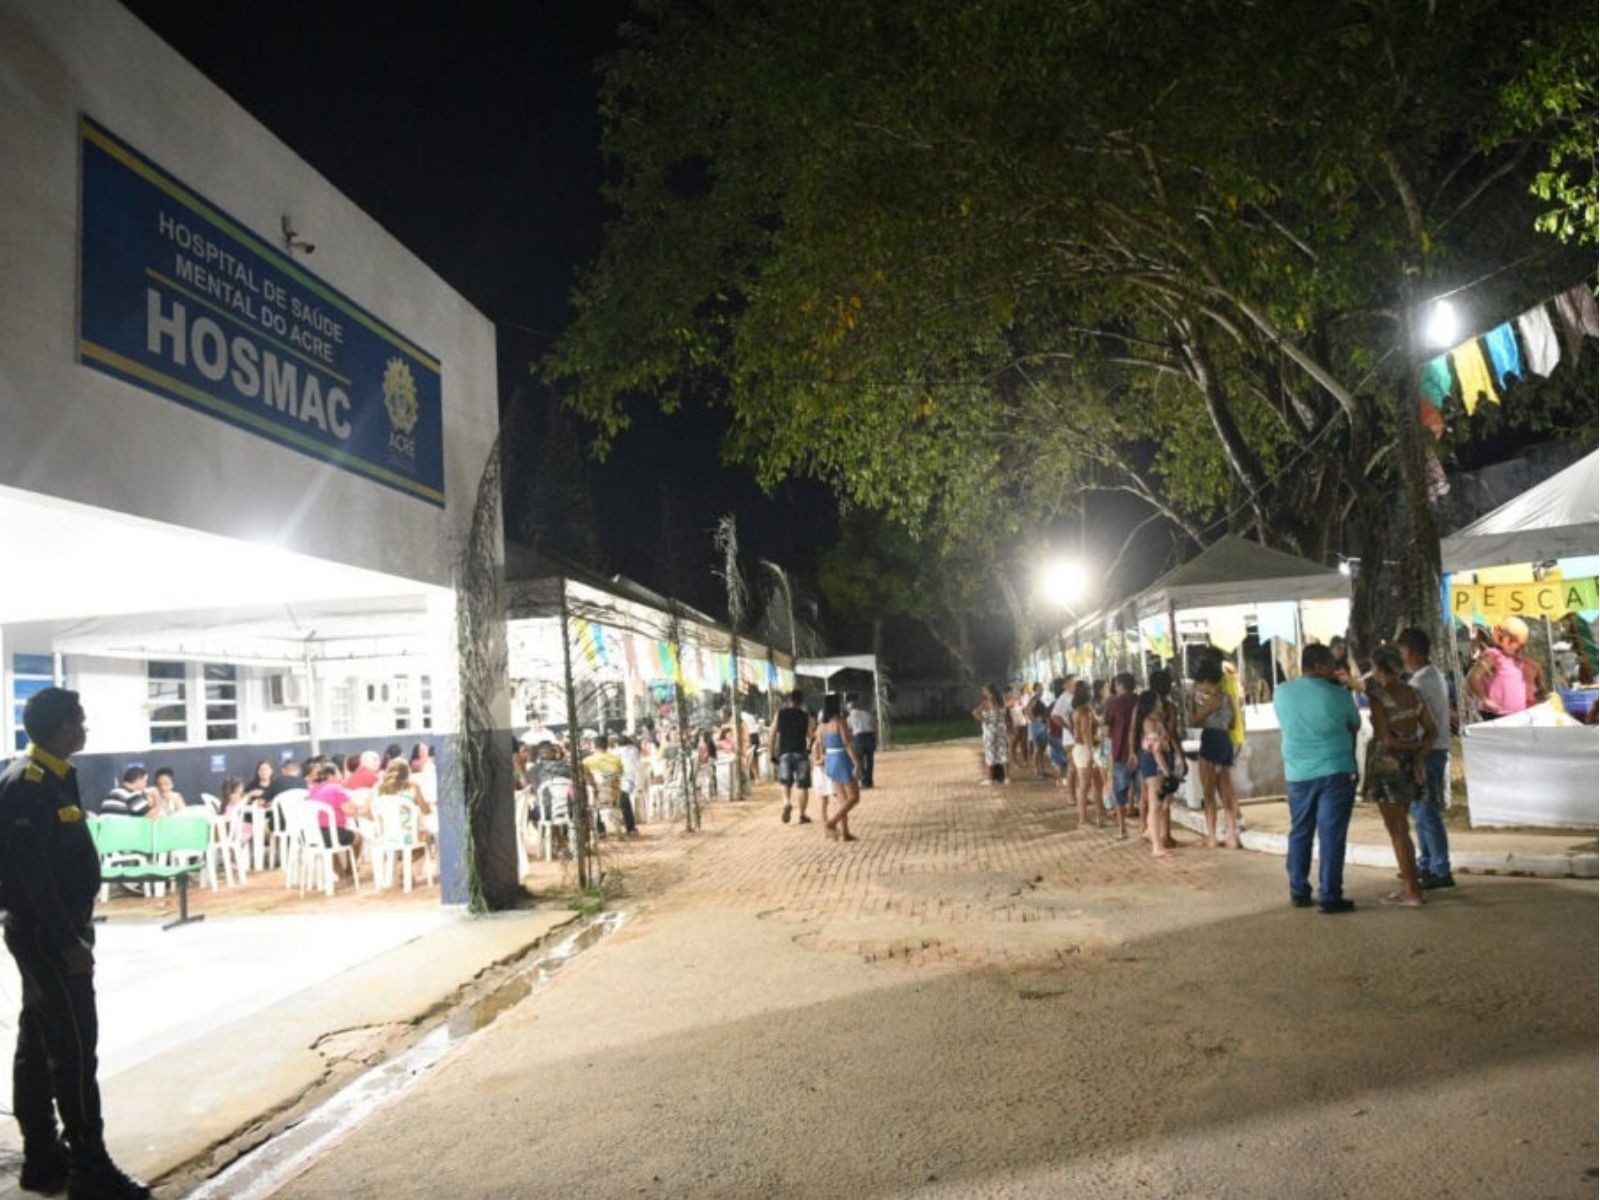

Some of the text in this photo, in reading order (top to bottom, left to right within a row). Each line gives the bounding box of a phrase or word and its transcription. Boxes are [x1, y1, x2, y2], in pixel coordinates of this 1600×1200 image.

[159, 211, 344, 343] HOSPITAL DE SAÚDE
[176, 253, 334, 364] MENTAL DO ACRE
[147, 287, 352, 440] HOSMAC
[388, 429, 416, 458] ACRE
[1455, 577, 1599, 612] PESCA
